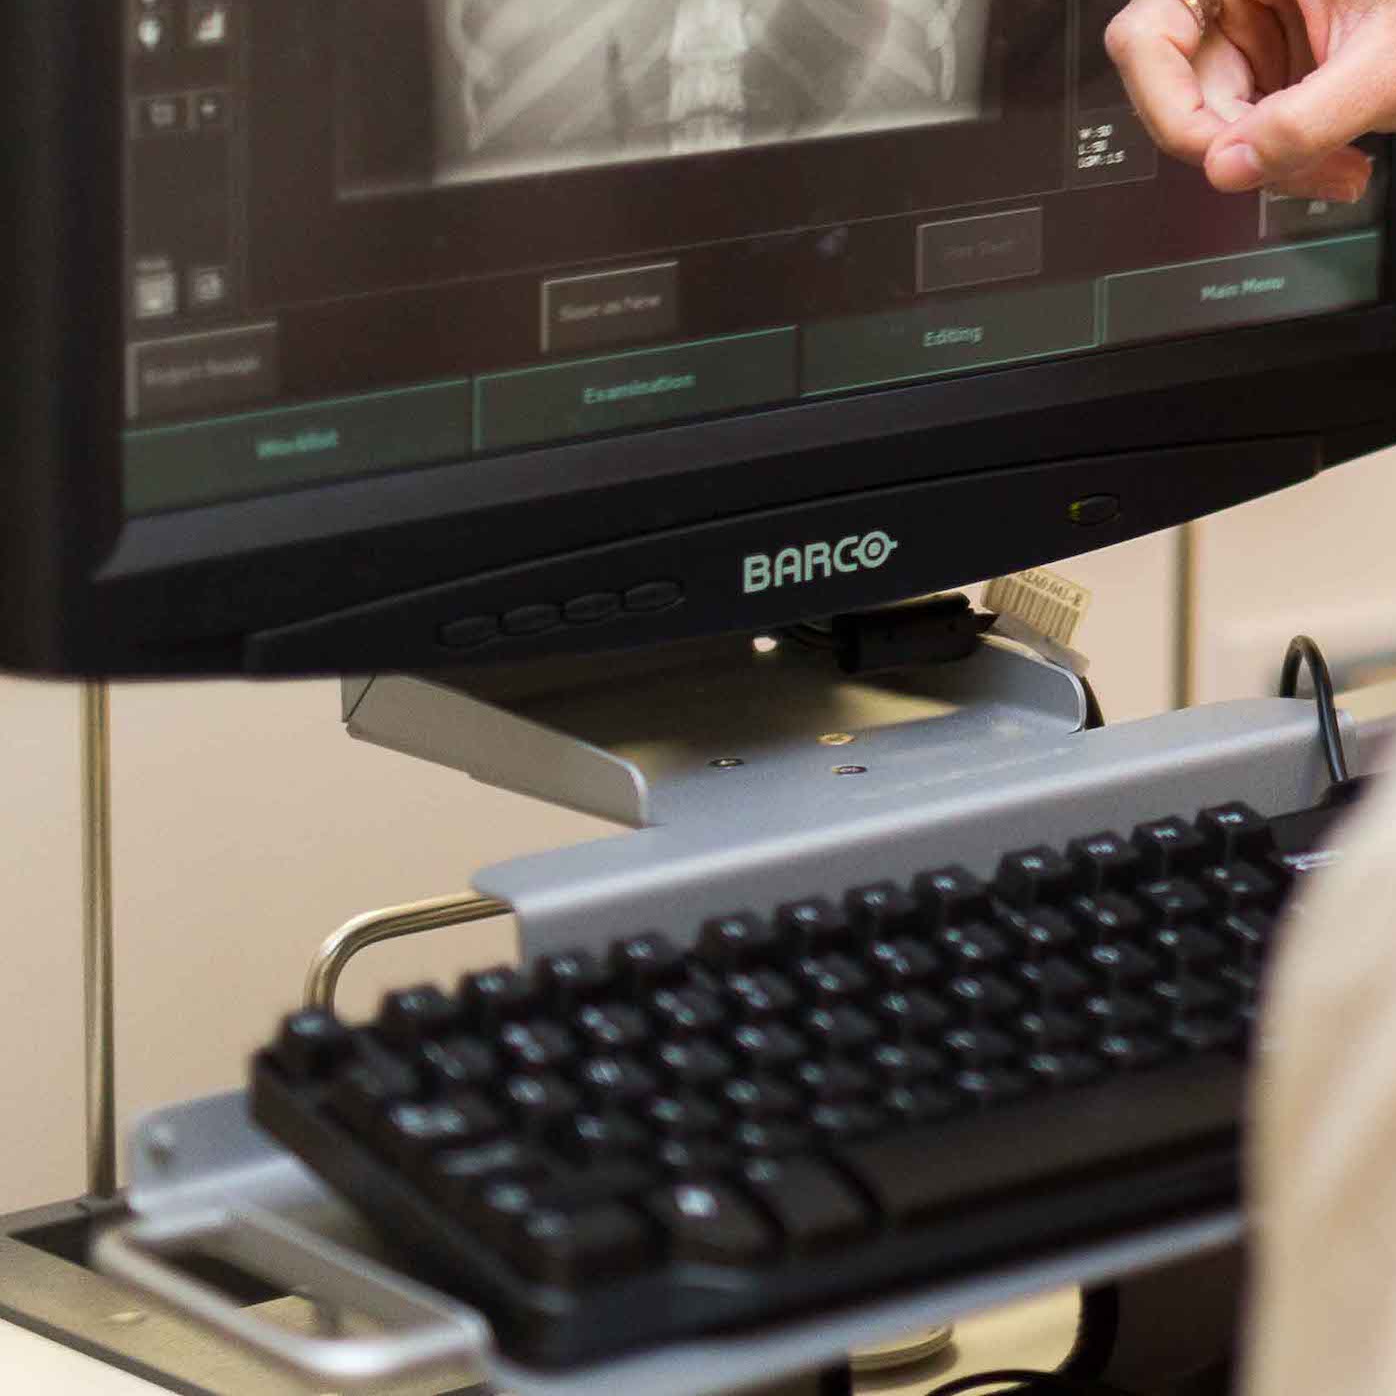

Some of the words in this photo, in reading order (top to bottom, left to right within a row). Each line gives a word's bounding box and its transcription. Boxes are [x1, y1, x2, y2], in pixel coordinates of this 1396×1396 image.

[1201, 283, 1240, 301] Main
[1241, 276, 1286, 296] Menu
[924, 325, 984, 348] Editing
[582, 374, 697, 405] Examination
[743, 530, 899, 594] BARCO
